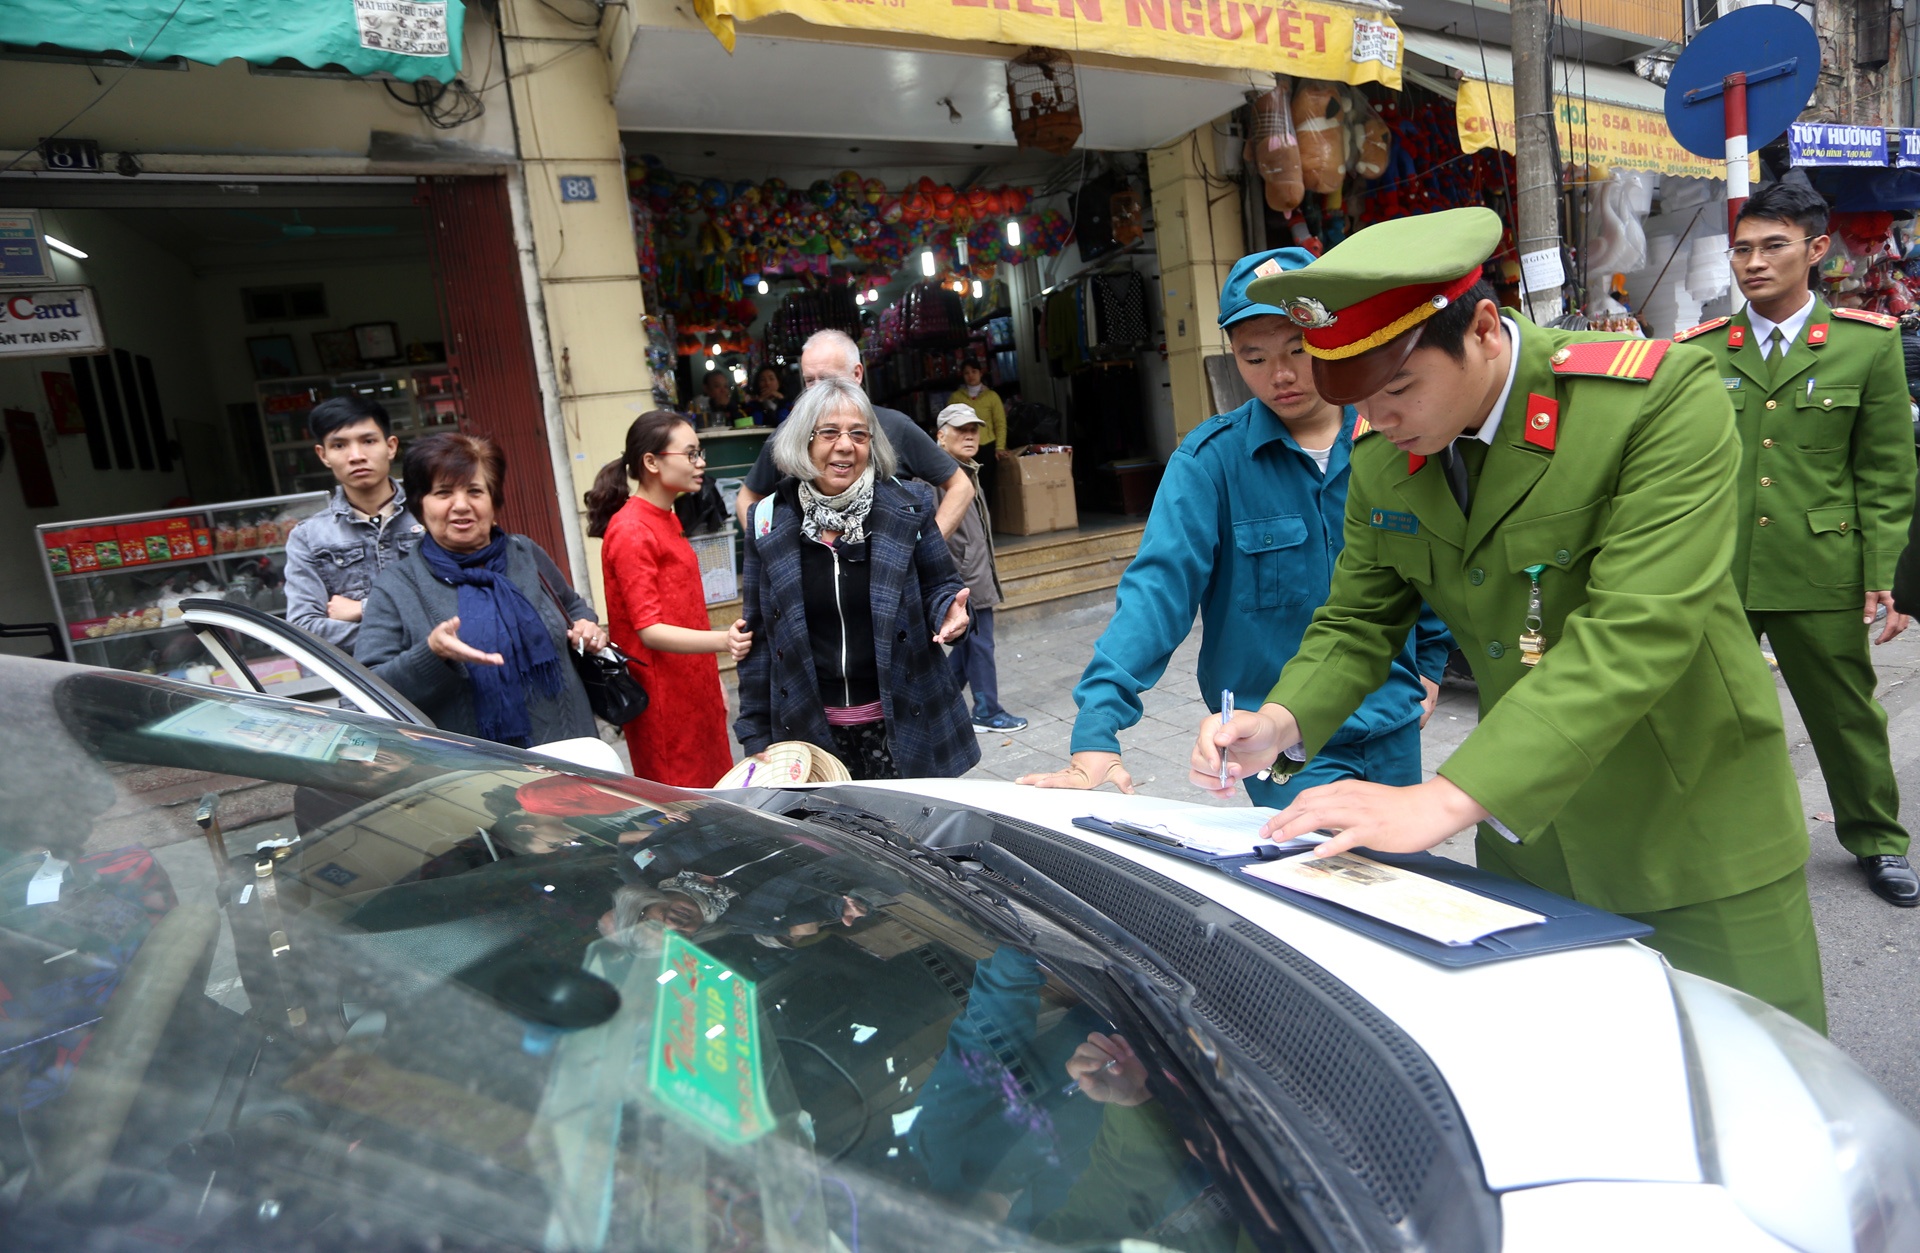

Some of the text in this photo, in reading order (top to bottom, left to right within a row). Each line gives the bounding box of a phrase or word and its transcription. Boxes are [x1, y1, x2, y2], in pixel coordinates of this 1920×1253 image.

[1127, 0, 1331, 58] NGUYỆT
[1602, 113, 1631, 132] 85A
[53, 143, 91, 168] 81
[567, 180, 590, 198] 83
[49, 329, 81, 343] ĐÂY
